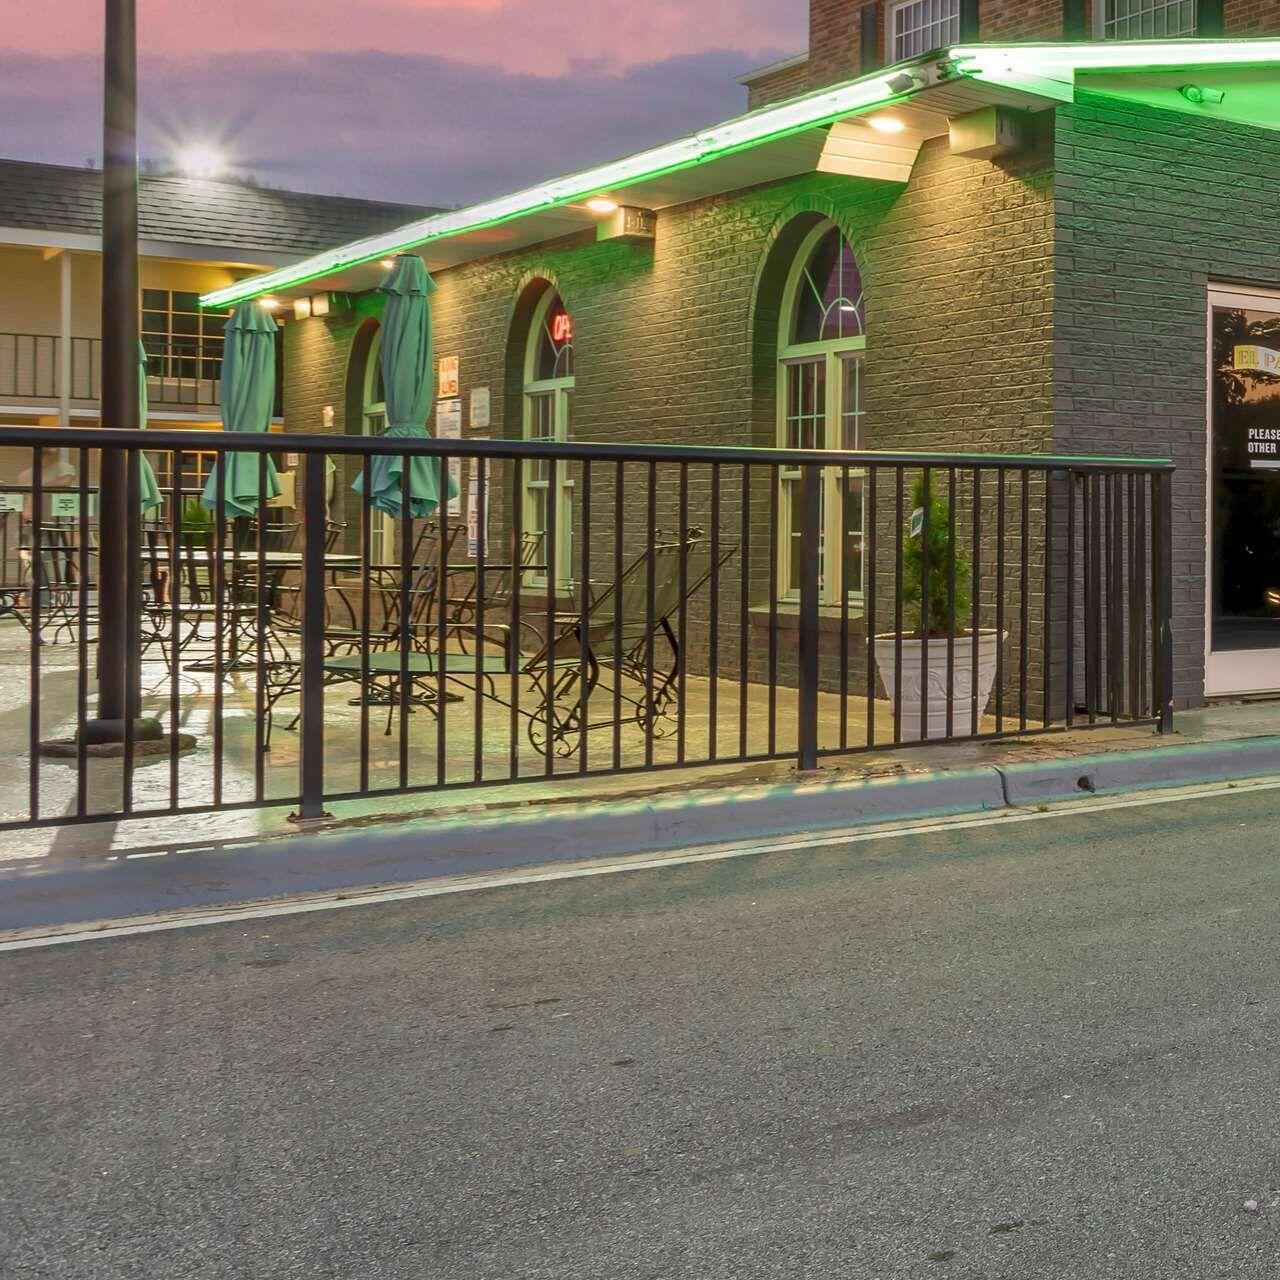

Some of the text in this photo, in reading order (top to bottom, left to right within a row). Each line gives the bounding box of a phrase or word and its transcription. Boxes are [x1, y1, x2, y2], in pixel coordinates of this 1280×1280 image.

[554, 315, 572, 340] OP
[1238, 350, 1259, 365] EL
[1248, 442, 1277, 454] OTHER
